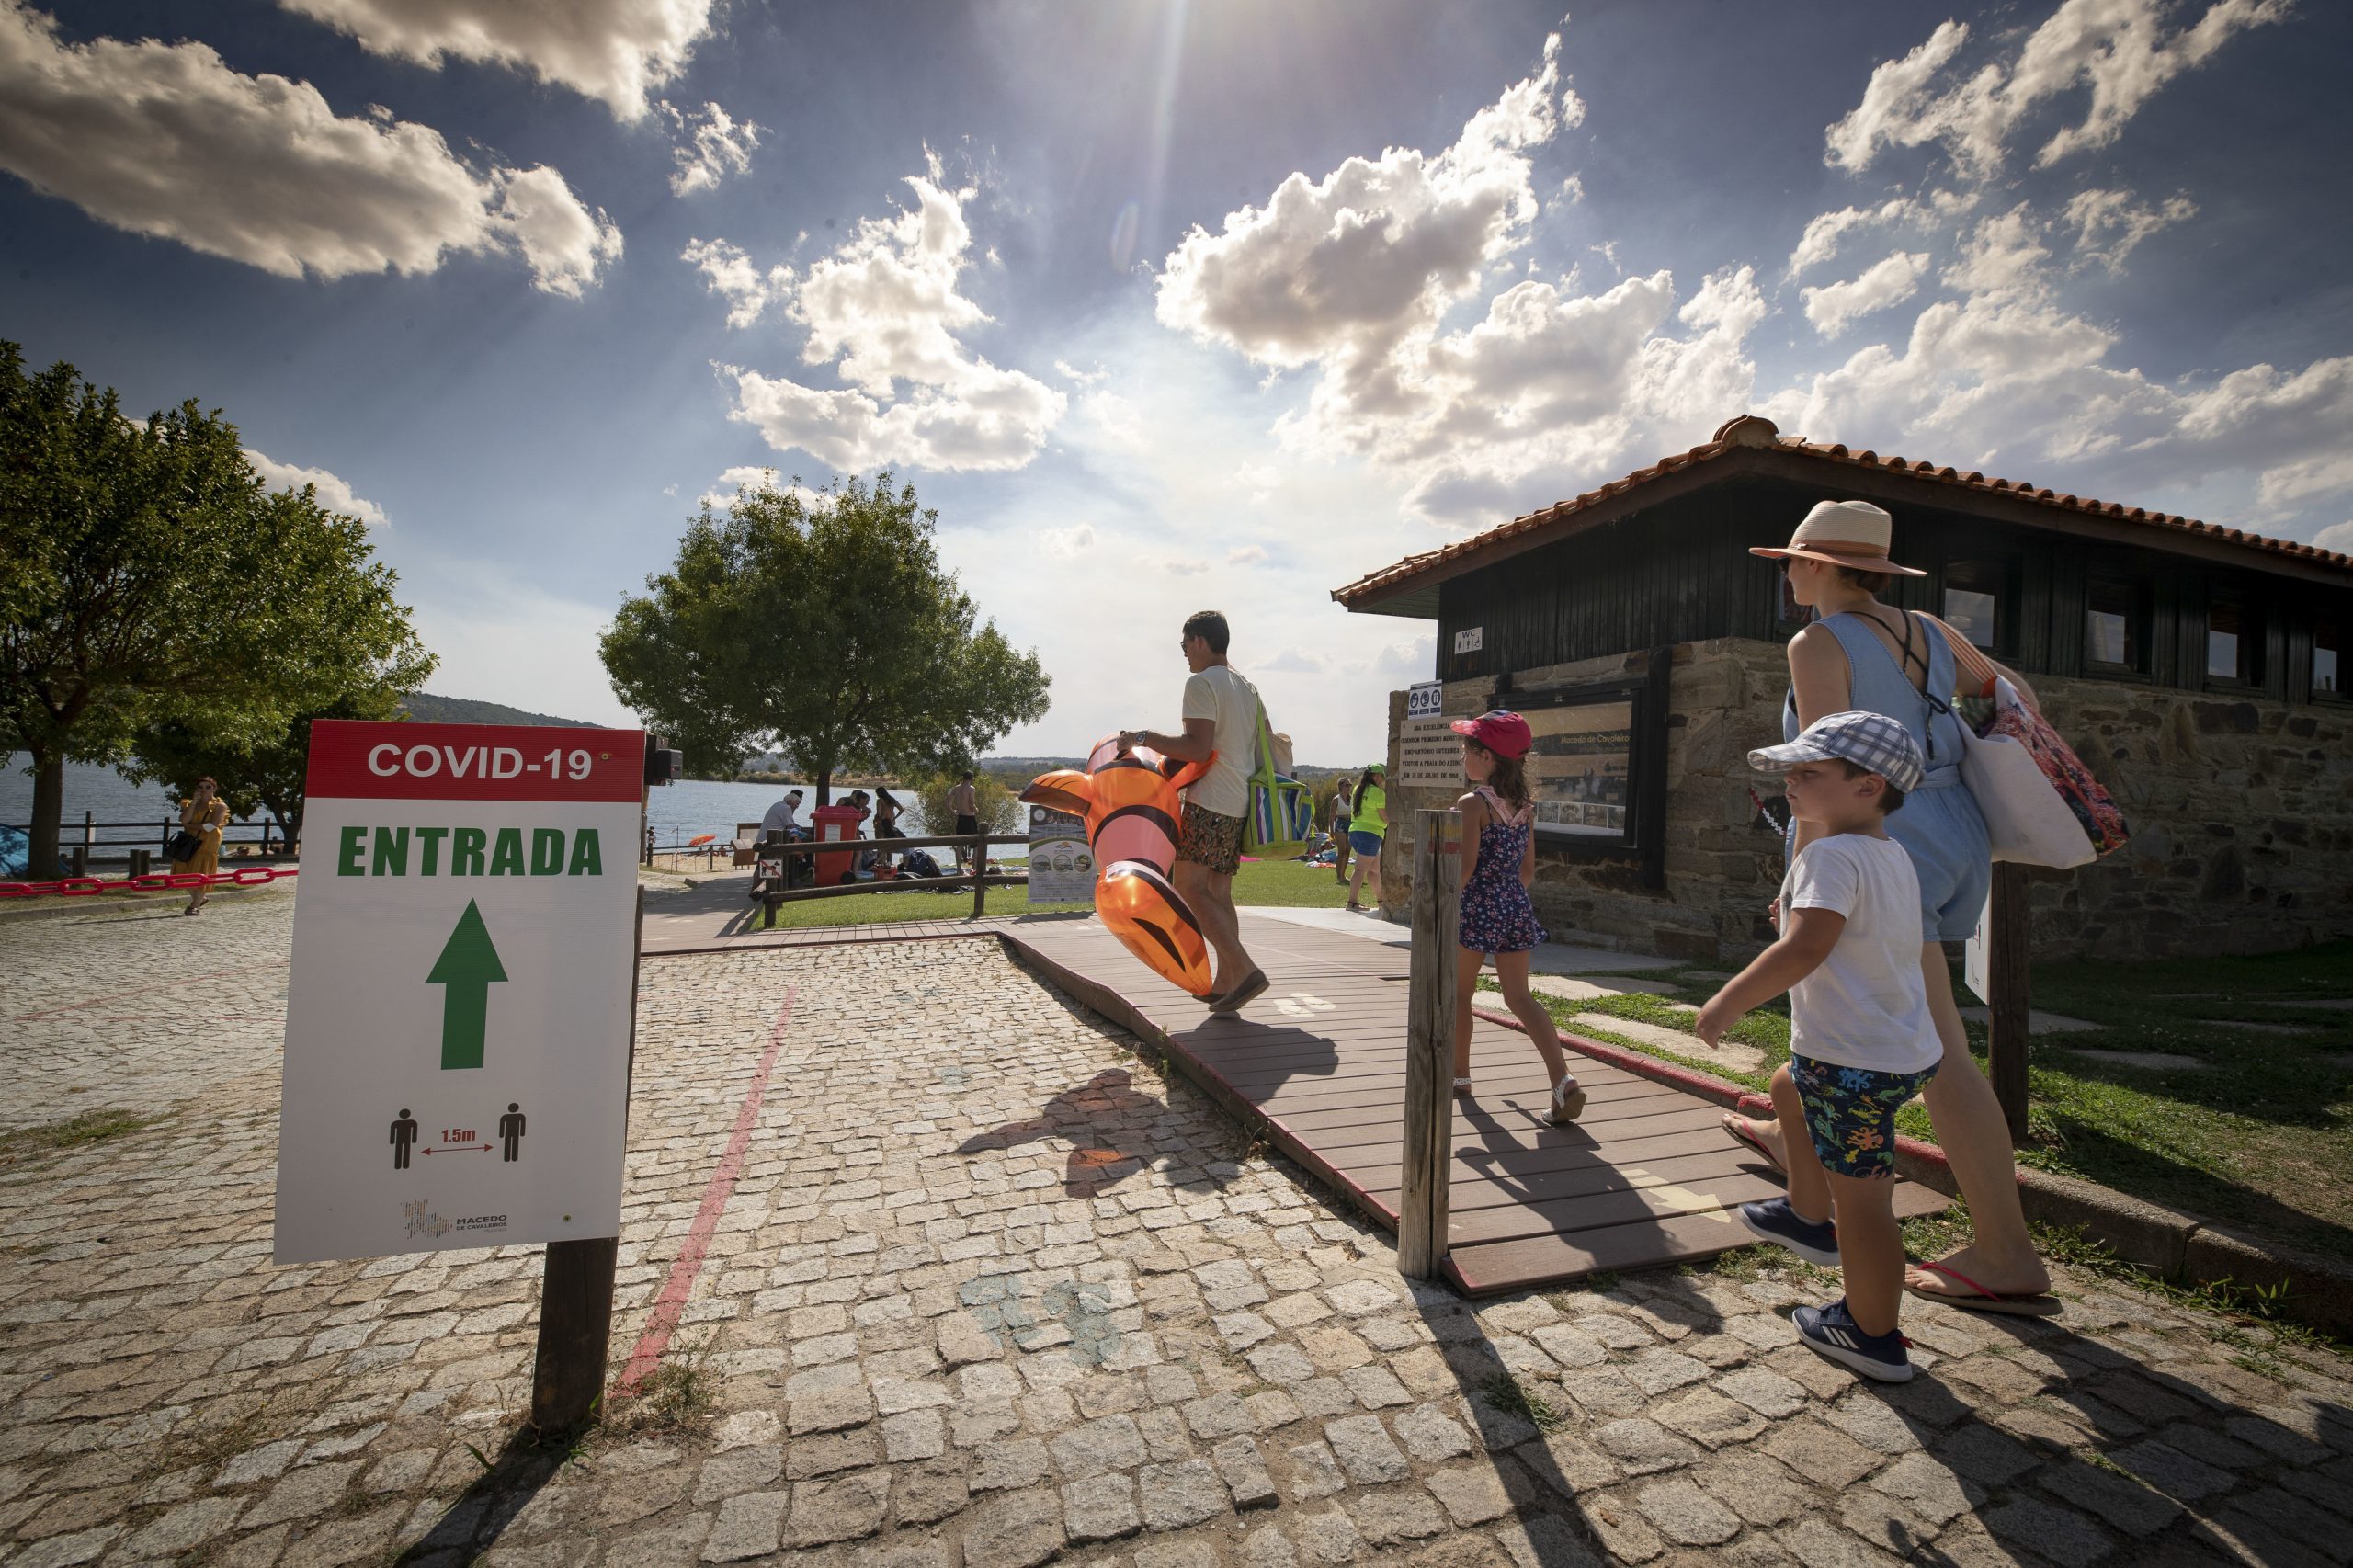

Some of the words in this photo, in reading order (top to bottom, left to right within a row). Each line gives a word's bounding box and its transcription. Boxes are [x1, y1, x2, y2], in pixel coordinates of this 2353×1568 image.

[1461, 629, 1475, 639] WC
[1560, 736, 1586, 744] Macedo
[1586, 735, 1597, 744] de
[1597, 734, 1631, 743] Cavaleiro
[368, 744, 592, 780] COVID-19
[337, 826, 603, 877] ENTRADA
[441, 1128, 476, 1142] 1.5m
[456, 1214, 507, 1225] MACEDO
[467, 1221, 507, 1230] CAVALEIROS
